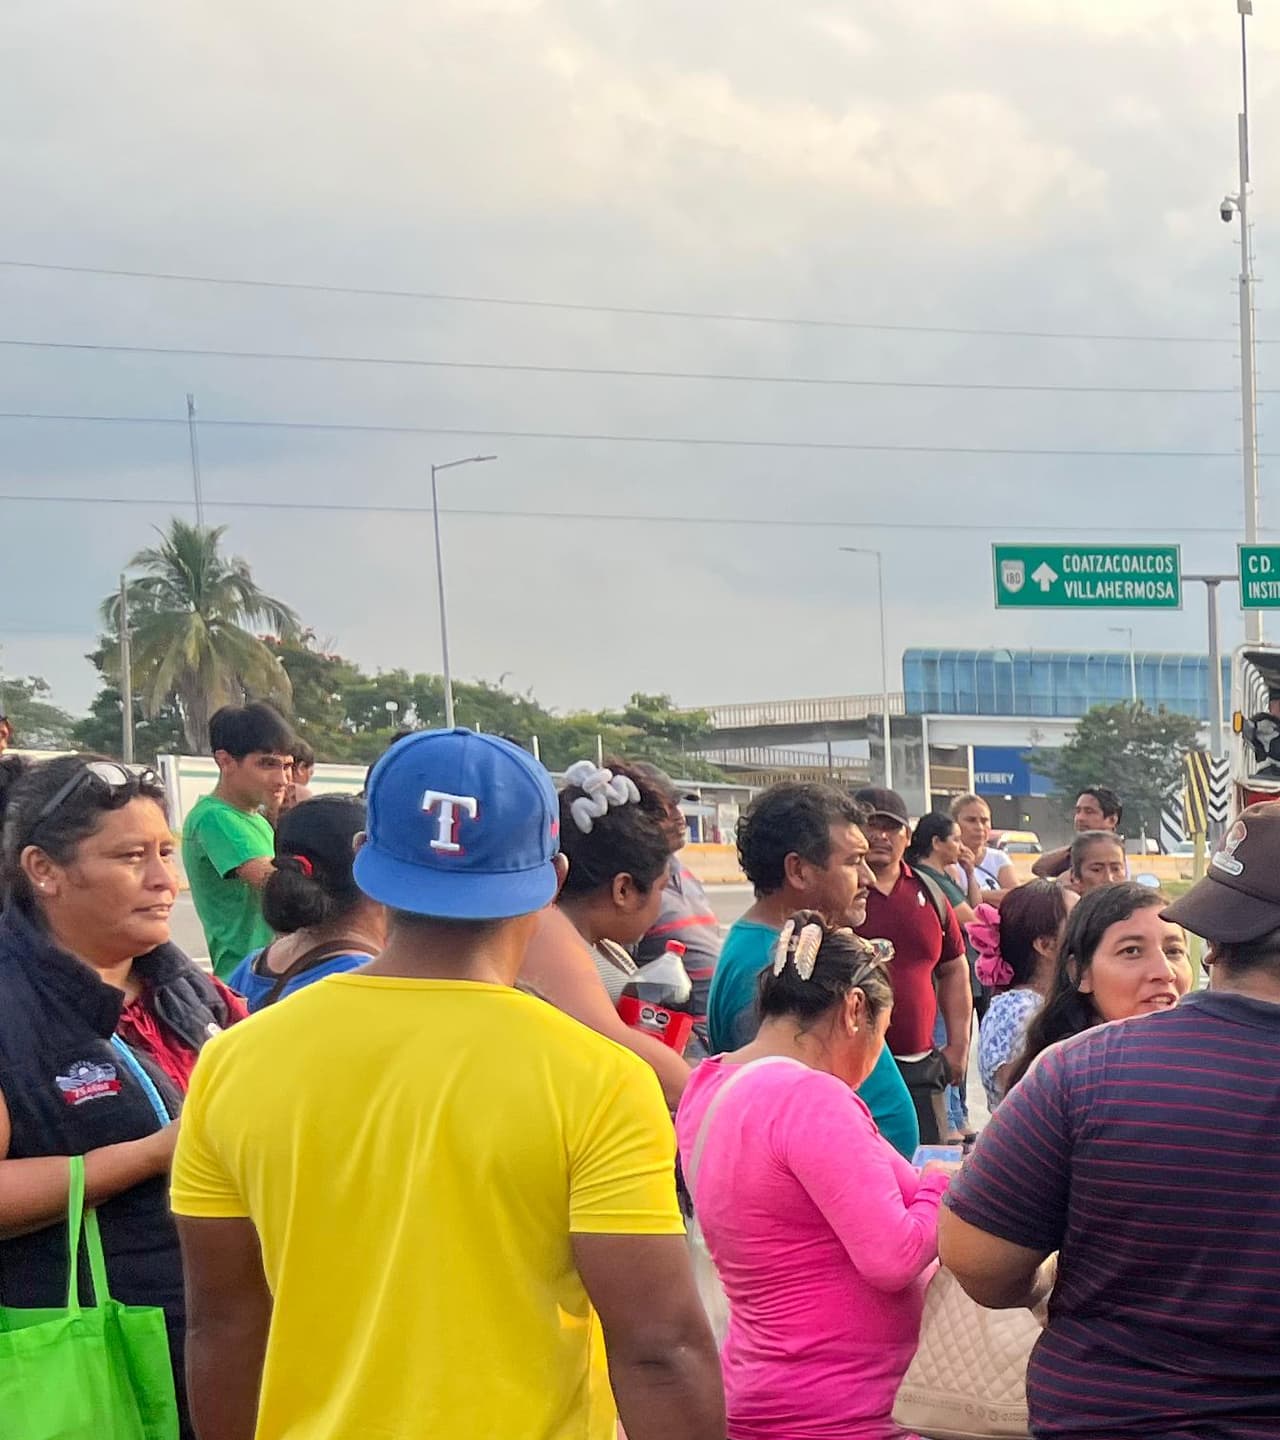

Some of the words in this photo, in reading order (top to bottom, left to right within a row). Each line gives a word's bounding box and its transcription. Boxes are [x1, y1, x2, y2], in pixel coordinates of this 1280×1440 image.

[1062, 555, 1173, 573] COATZACOALCOS
[1249, 555, 1275, 573] CD.
[1006, 572, 1021, 584] 180
[1064, 581, 1175, 599] VILLAHERMOSA
[422, 790, 479, 853] T
